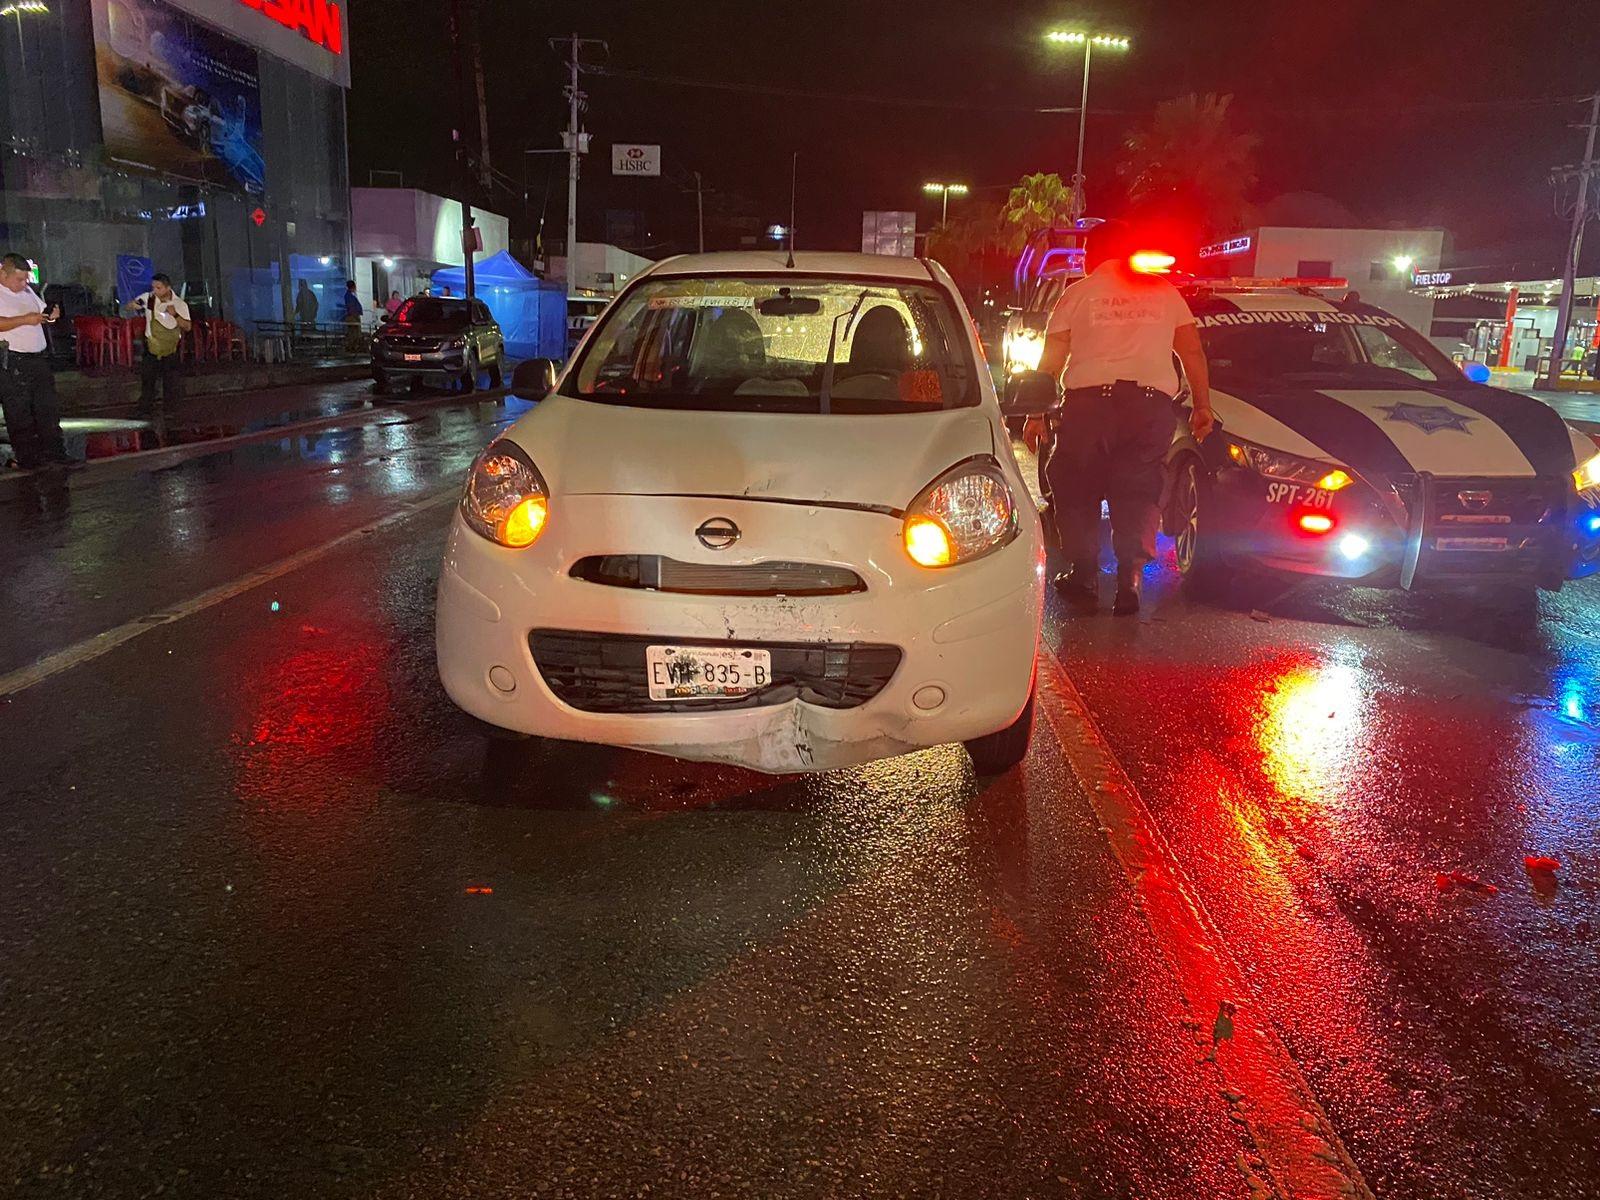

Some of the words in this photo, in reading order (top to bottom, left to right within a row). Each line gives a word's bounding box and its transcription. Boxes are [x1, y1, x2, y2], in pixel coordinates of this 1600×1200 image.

[619, 159, 652, 171] HSBC
[1415, 274, 1431, 285] FUEL
[1431, 272, 1451, 285] STOP
[1266, 482, 1335, 510] SPT-261
